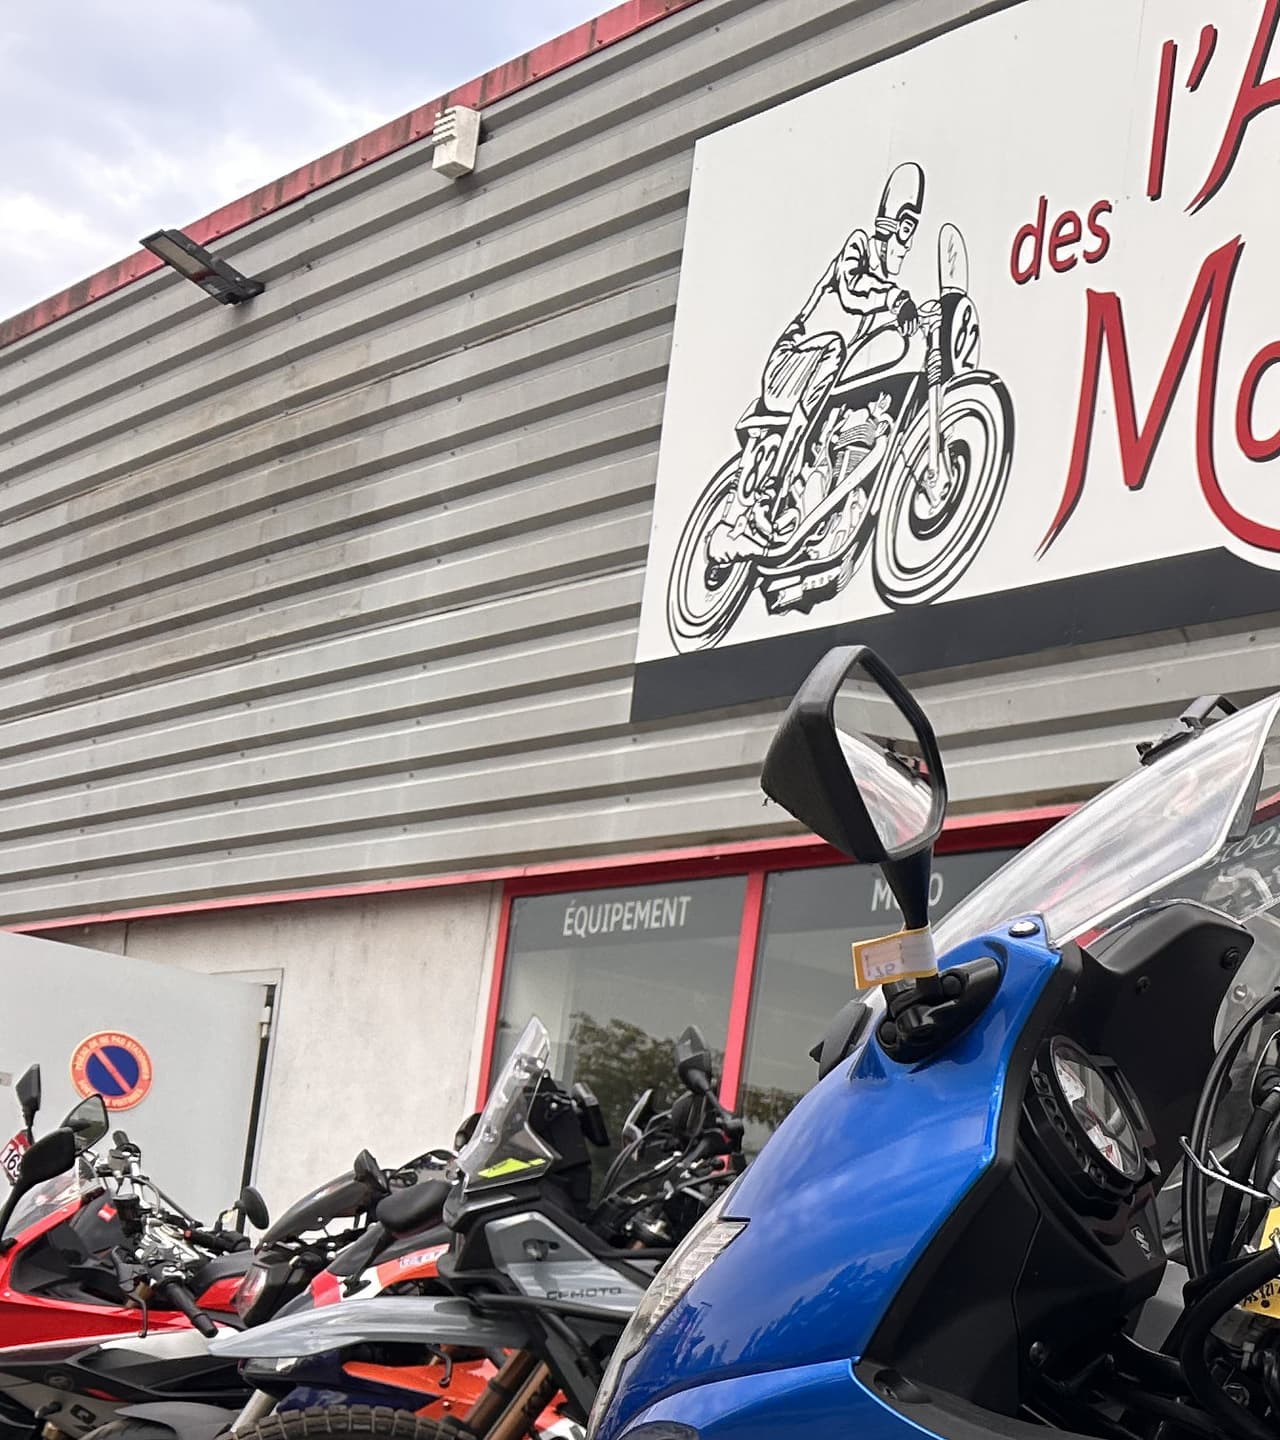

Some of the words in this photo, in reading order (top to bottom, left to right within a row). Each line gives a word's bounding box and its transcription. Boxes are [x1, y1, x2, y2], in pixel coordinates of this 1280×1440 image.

[1011, 196, 1112, 285] des
[955, 305, 979, 369] 82
[562, 896, 692, 938] ÉQUIPEMENT
[871, 872, 943, 911] MO
